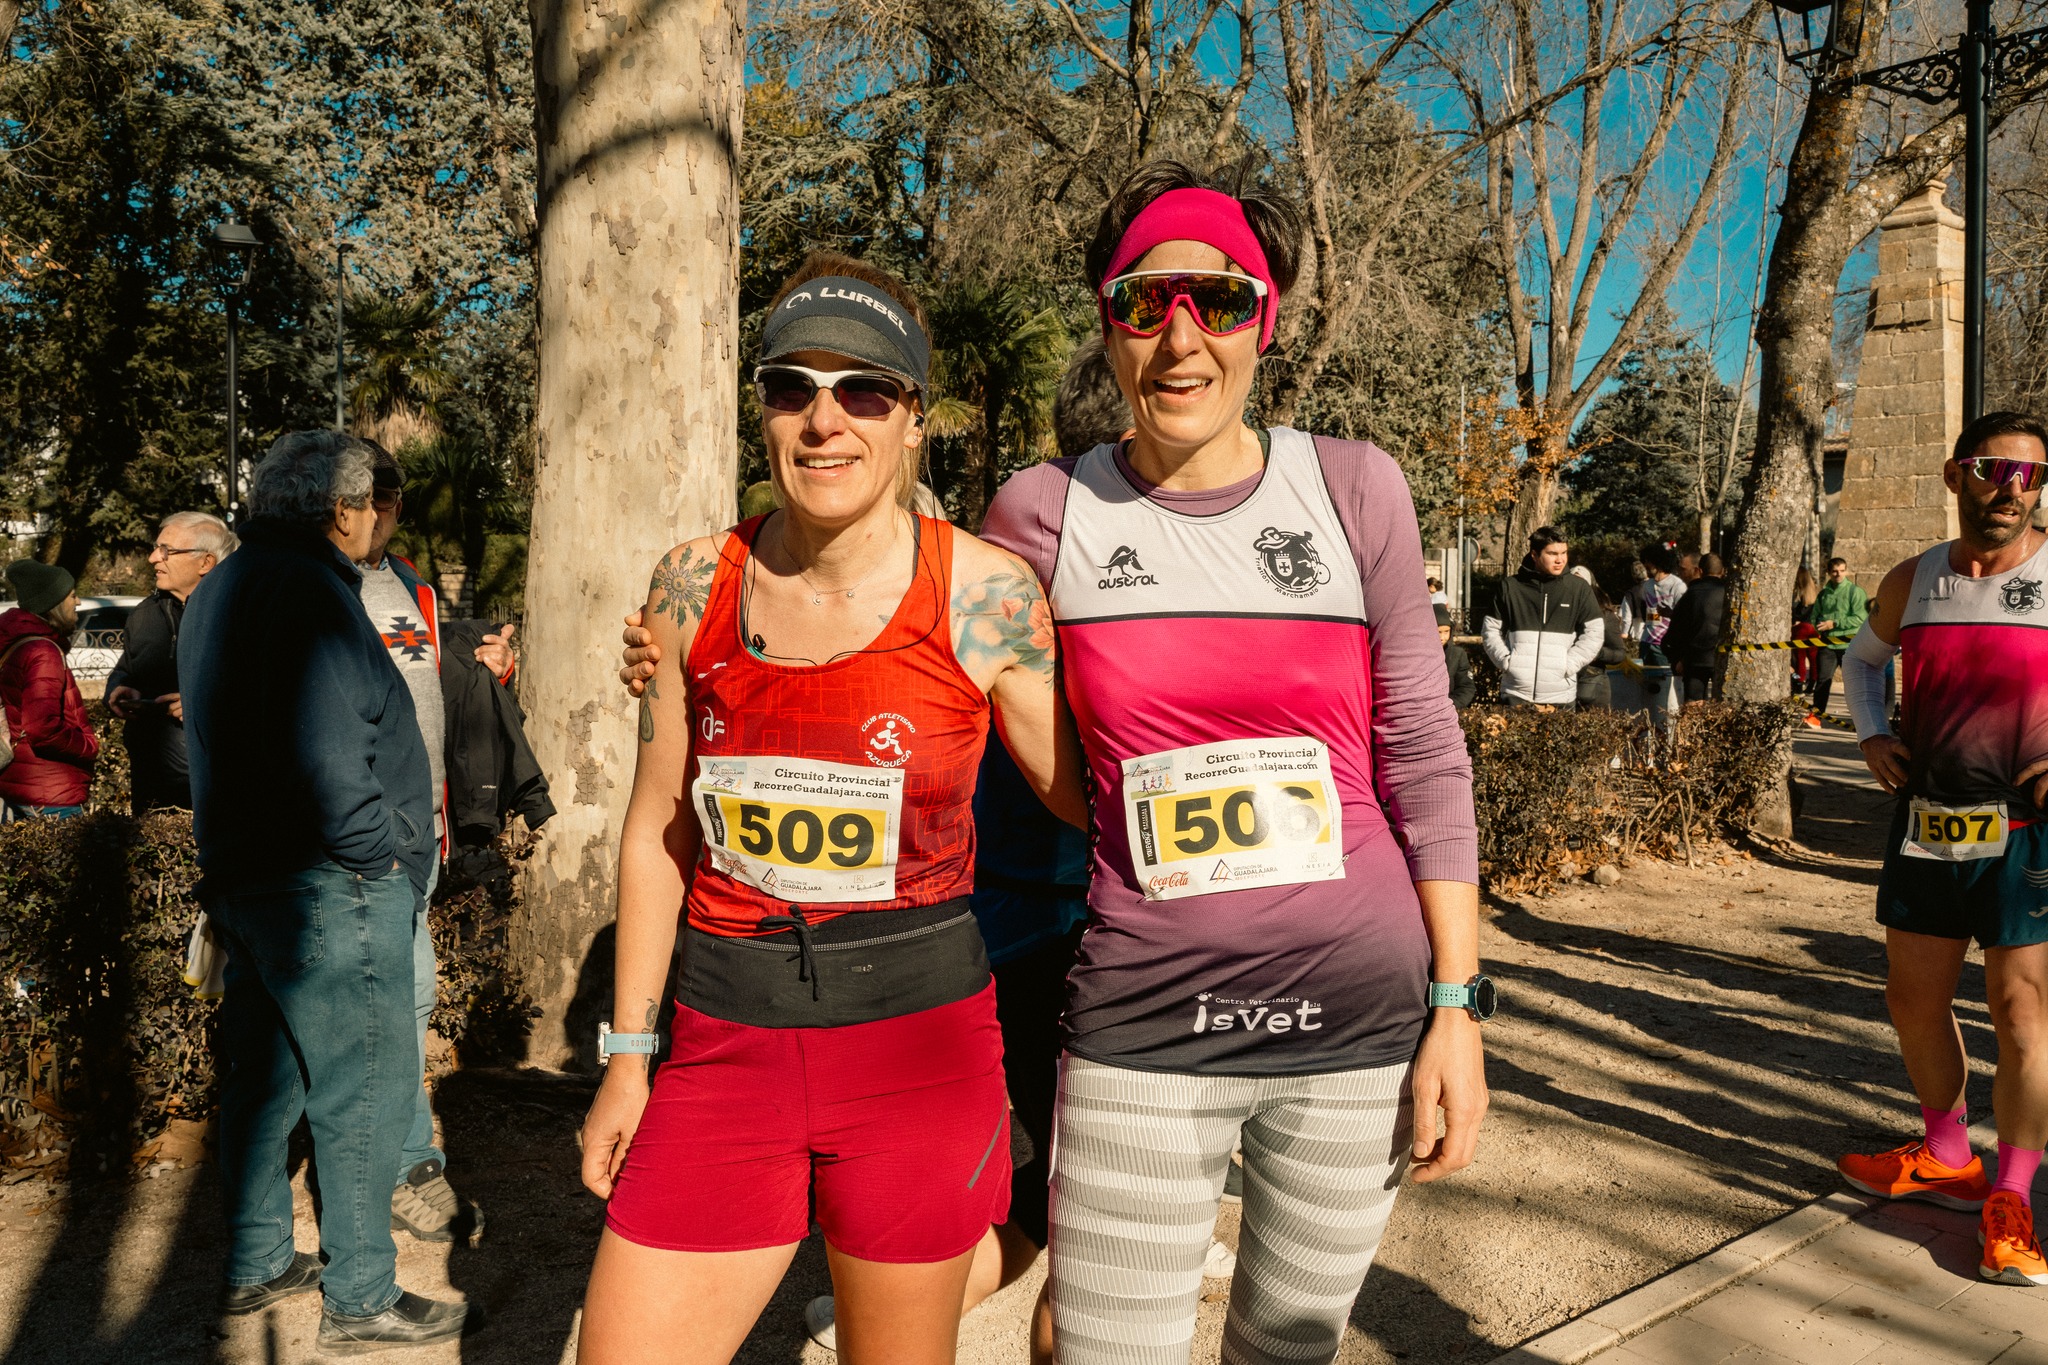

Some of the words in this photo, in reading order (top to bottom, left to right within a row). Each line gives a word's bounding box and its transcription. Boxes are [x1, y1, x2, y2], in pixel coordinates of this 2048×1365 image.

[819, 287, 908, 336] LURBEL
[1097, 574, 1160, 590] austral
[861, 715, 877, 732] CLUB
[878, 712, 916, 733] ATLETISMO
[865, 750, 912, 768] AZUQUECA
[1206, 751, 1256, 765] Circuito
[1258, 748, 1318, 759] Provincial
[774, 768, 824, 781] Circuito
[827, 773, 891, 787] Provincial
[1185, 762, 1319, 781] RecorreGuadalajara.com
[753, 781, 890, 800] RecorreGuadalajara.com
[1173, 786, 1321, 855] 506
[1927, 814, 1994, 843] 507
[738, 803, 875, 868] 509
[1234, 866, 1279, 877] GUADALAJARA
[780, 882, 822, 891] GUADALAJARA
[1215, 997, 1245, 1005] Centro
[1248, 996, 1300, 1006] Veterinario
